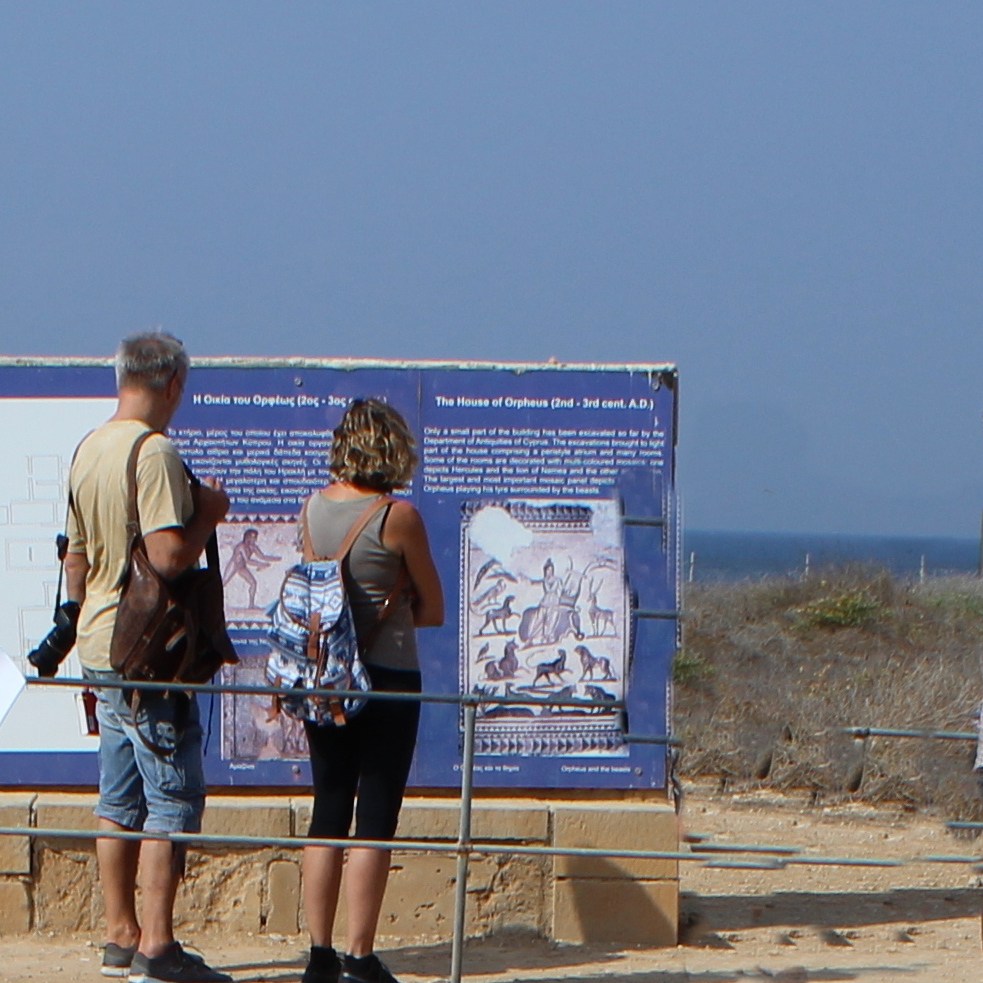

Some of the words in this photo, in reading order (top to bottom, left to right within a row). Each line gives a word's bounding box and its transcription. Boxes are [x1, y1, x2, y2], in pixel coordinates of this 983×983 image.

[203, 394, 230, 405] Οικία
[233, 397, 251, 405] του
[253, 395, 296, 407] Ορφέως
[297, 395, 320, 407] (2ος
[328, 395, 347, 407] 3ος
[435, 397, 454, 407] The
[456, 397, 490, 407] House
[492, 397, 503, 407] of
[505, 397, 549, 409] Orpheus
[551, 397, 574, 409] (2nd
[583, 398, 600, 408] 3rd
[602, 399, 627, 408] cent.
[629, 398, 655, 410] A.D.)
[424, 426, 441, 436] Only
[451, 426, 470, 435] small
[472, 427, 486, 436] part
[512, 427, 540, 437] building
[542, 427, 556, 436] has
[558, 428, 577, 436] been
[424, 445, 438, 455] part
[466, 446, 488, 454] house
[424, 455, 445, 463] Some
[486, 465, 500, 473] and
[425, 474, 439, 482] The
[467, 474, 481, 483] and
[424, 484, 454, 494] Orpheus
